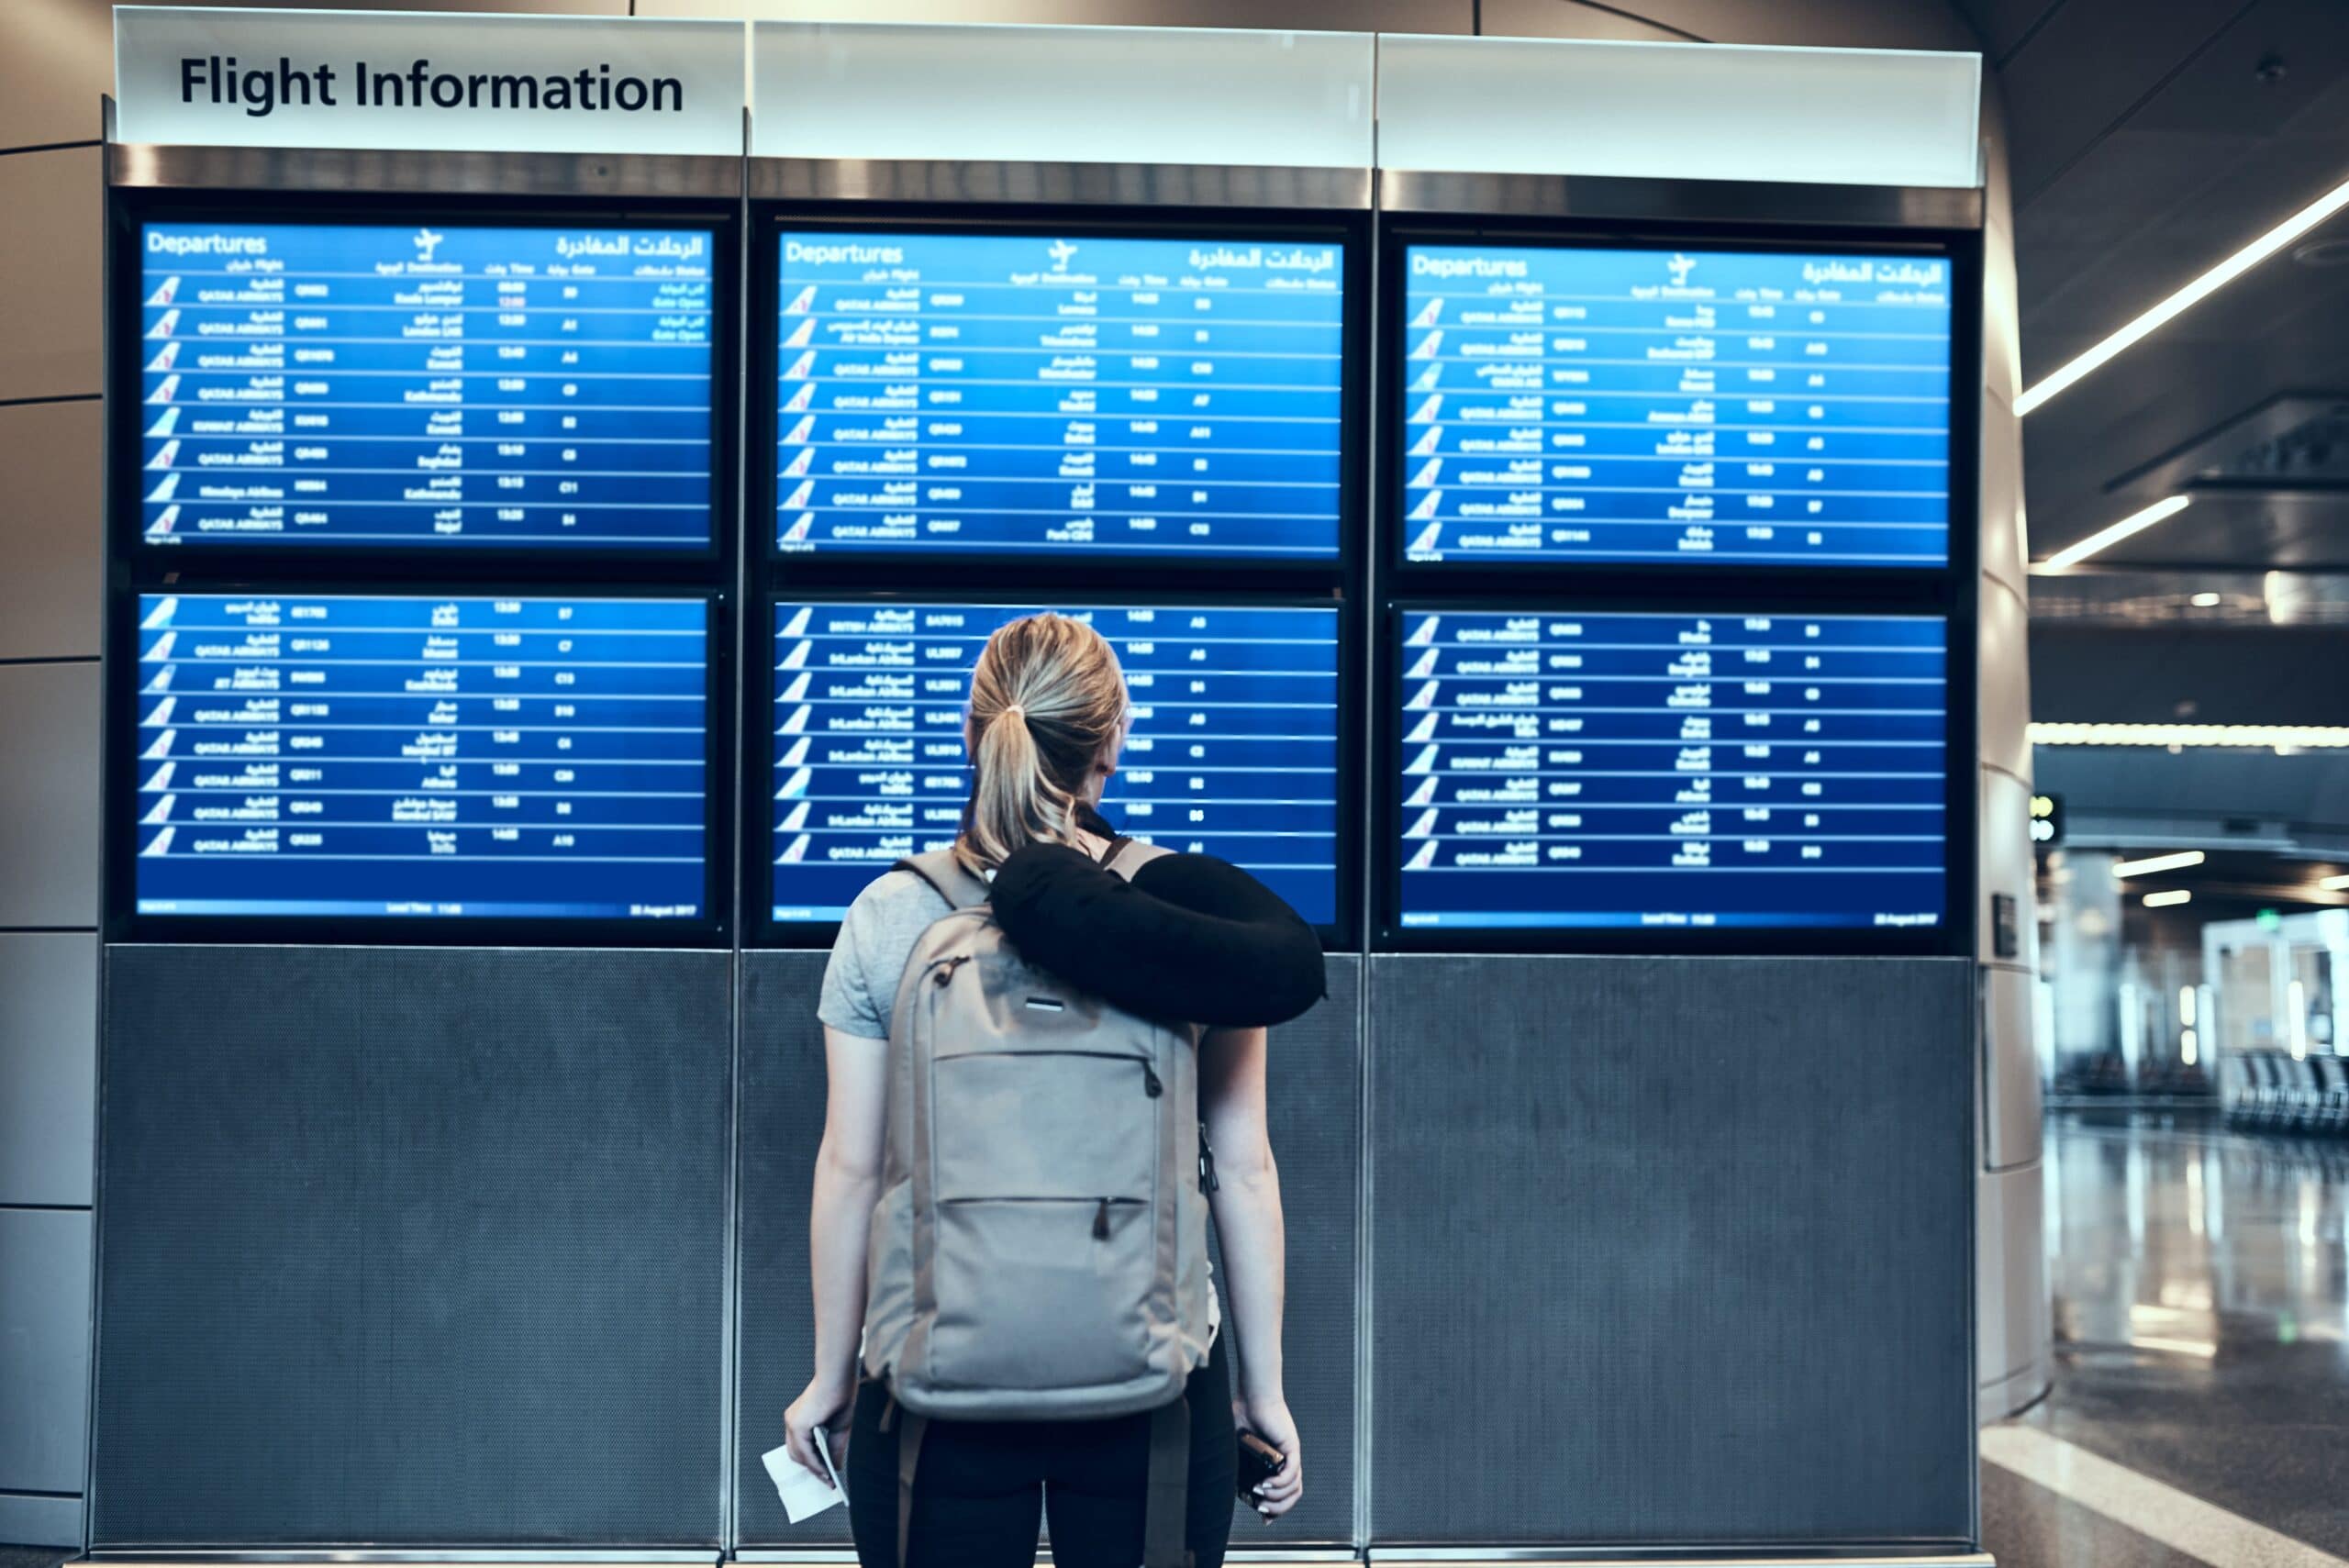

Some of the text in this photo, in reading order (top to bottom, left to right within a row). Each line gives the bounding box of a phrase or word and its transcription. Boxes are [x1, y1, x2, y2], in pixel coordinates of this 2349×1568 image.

[180, 56, 684, 117] Flight Information
[148, 232, 267, 255] Departures
[556, 236, 703, 260] الرحلات المغادرة
[786, 241, 903, 264] Departures
[1189, 249, 1333, 272] الرحلات المغادرة
[1413, 255, 1527, 278] Departures
[1803, 262, 1942, 287] الرحلات المغادرة
[829, 848, 865, 860] QATAR
